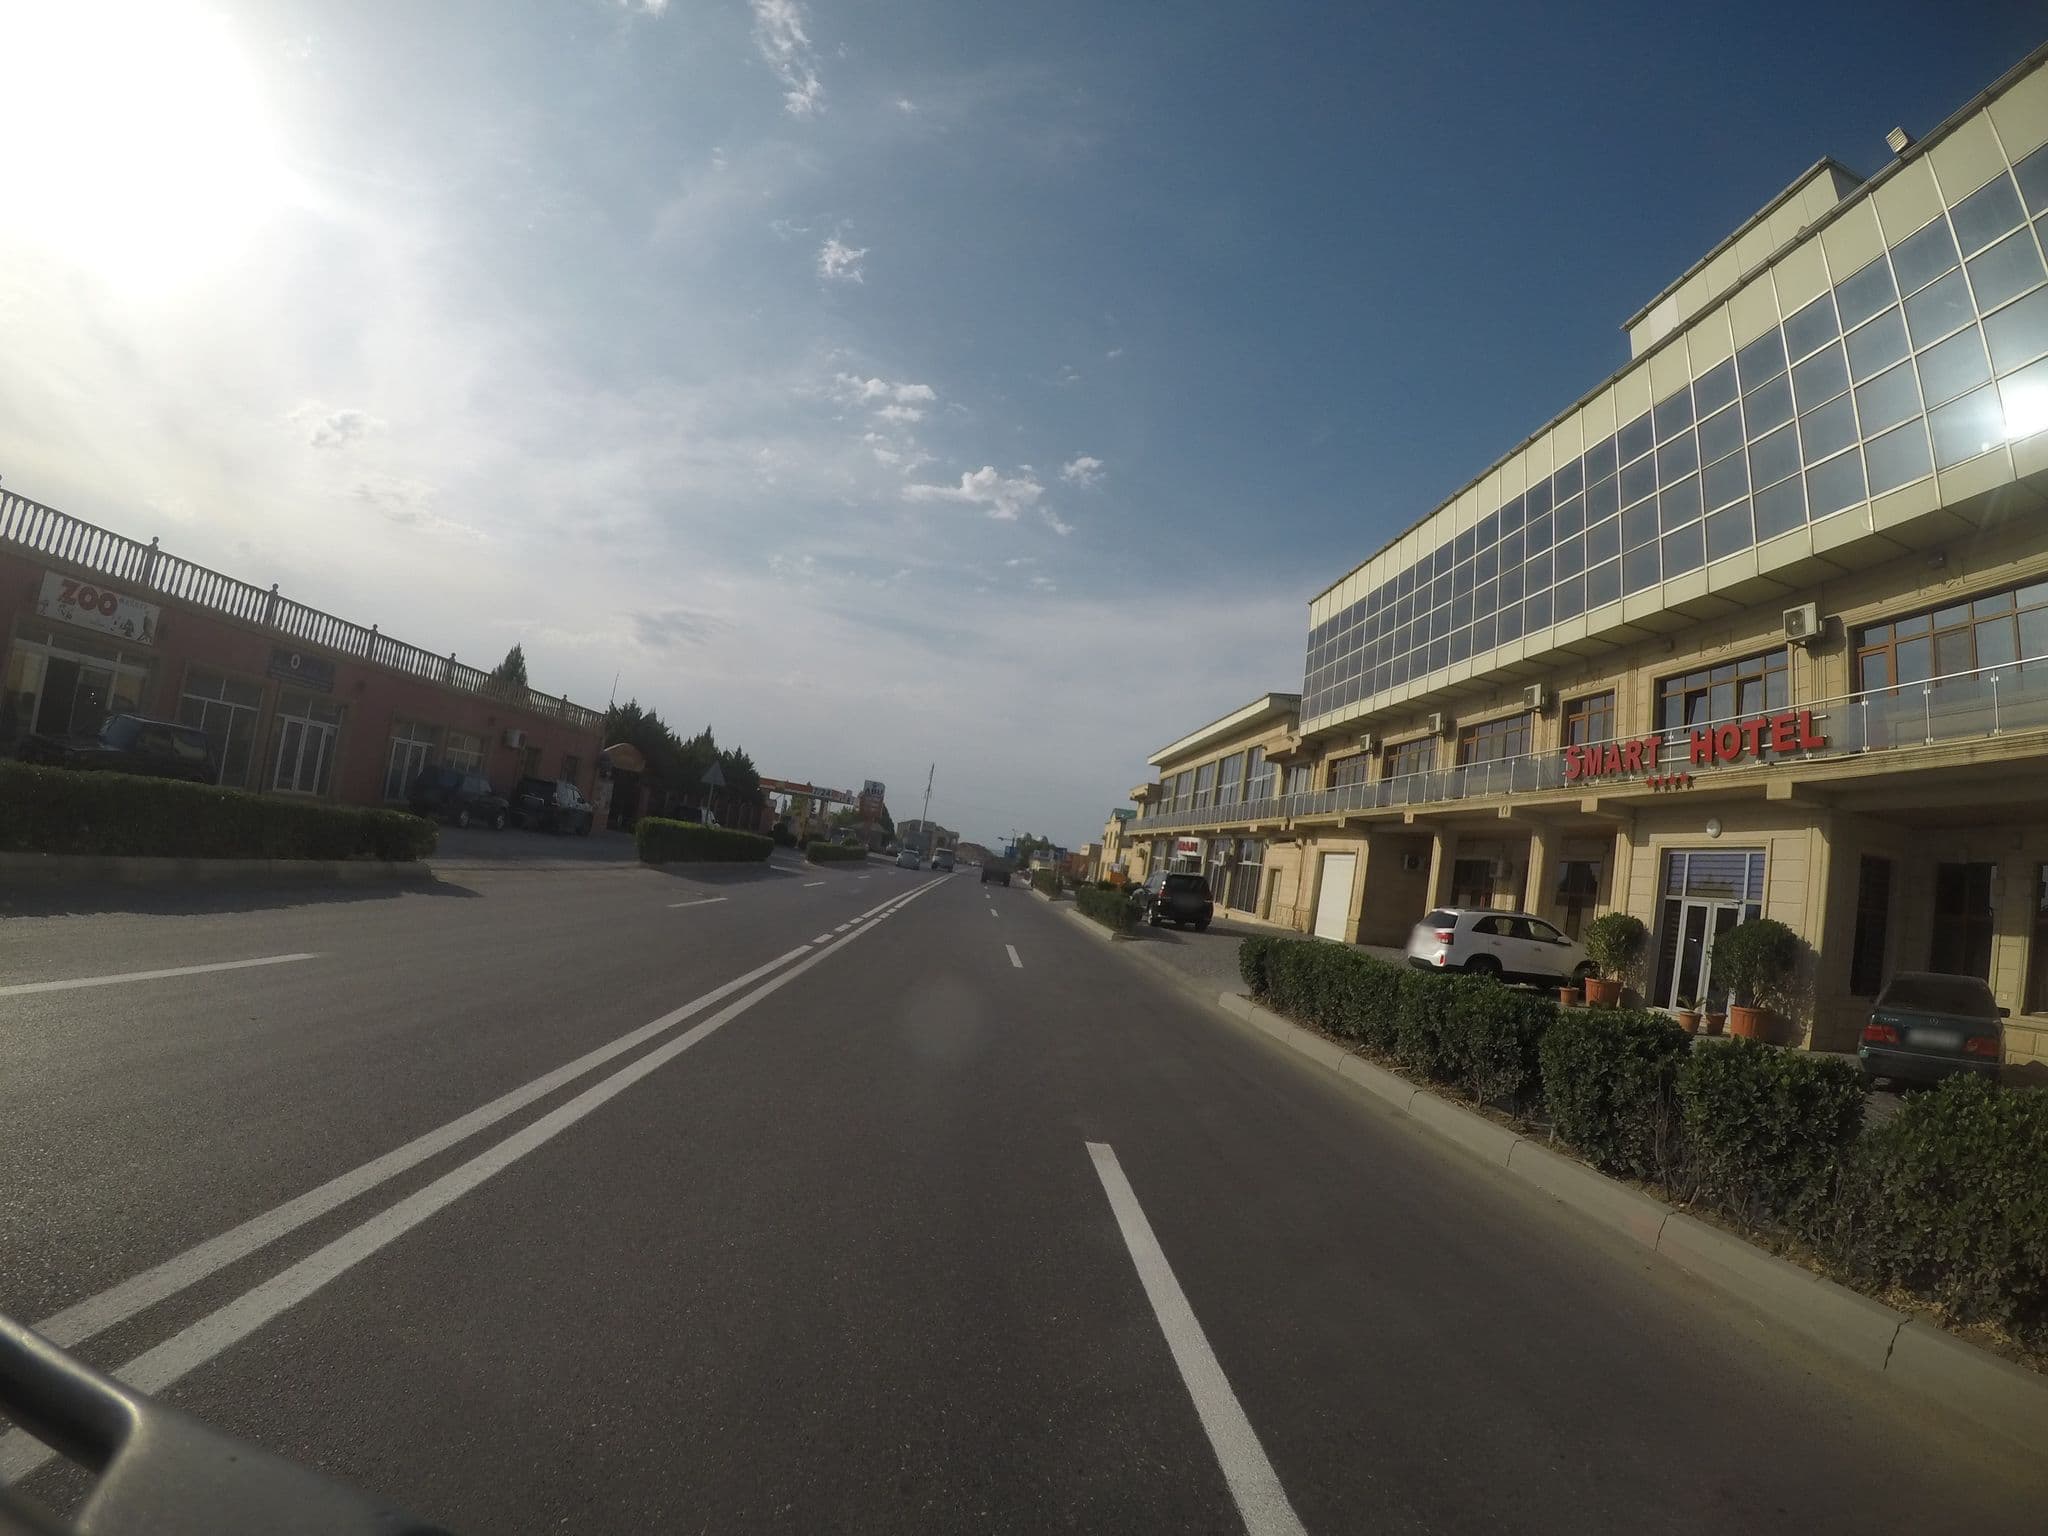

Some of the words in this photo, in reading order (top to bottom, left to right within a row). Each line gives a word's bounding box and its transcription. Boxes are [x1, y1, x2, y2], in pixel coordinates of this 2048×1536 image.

[57, 579, 118, 616] ZOO
[1563, 736, 1662, 779] SMART
[1690, 710, 1827, 765] HOTEL
